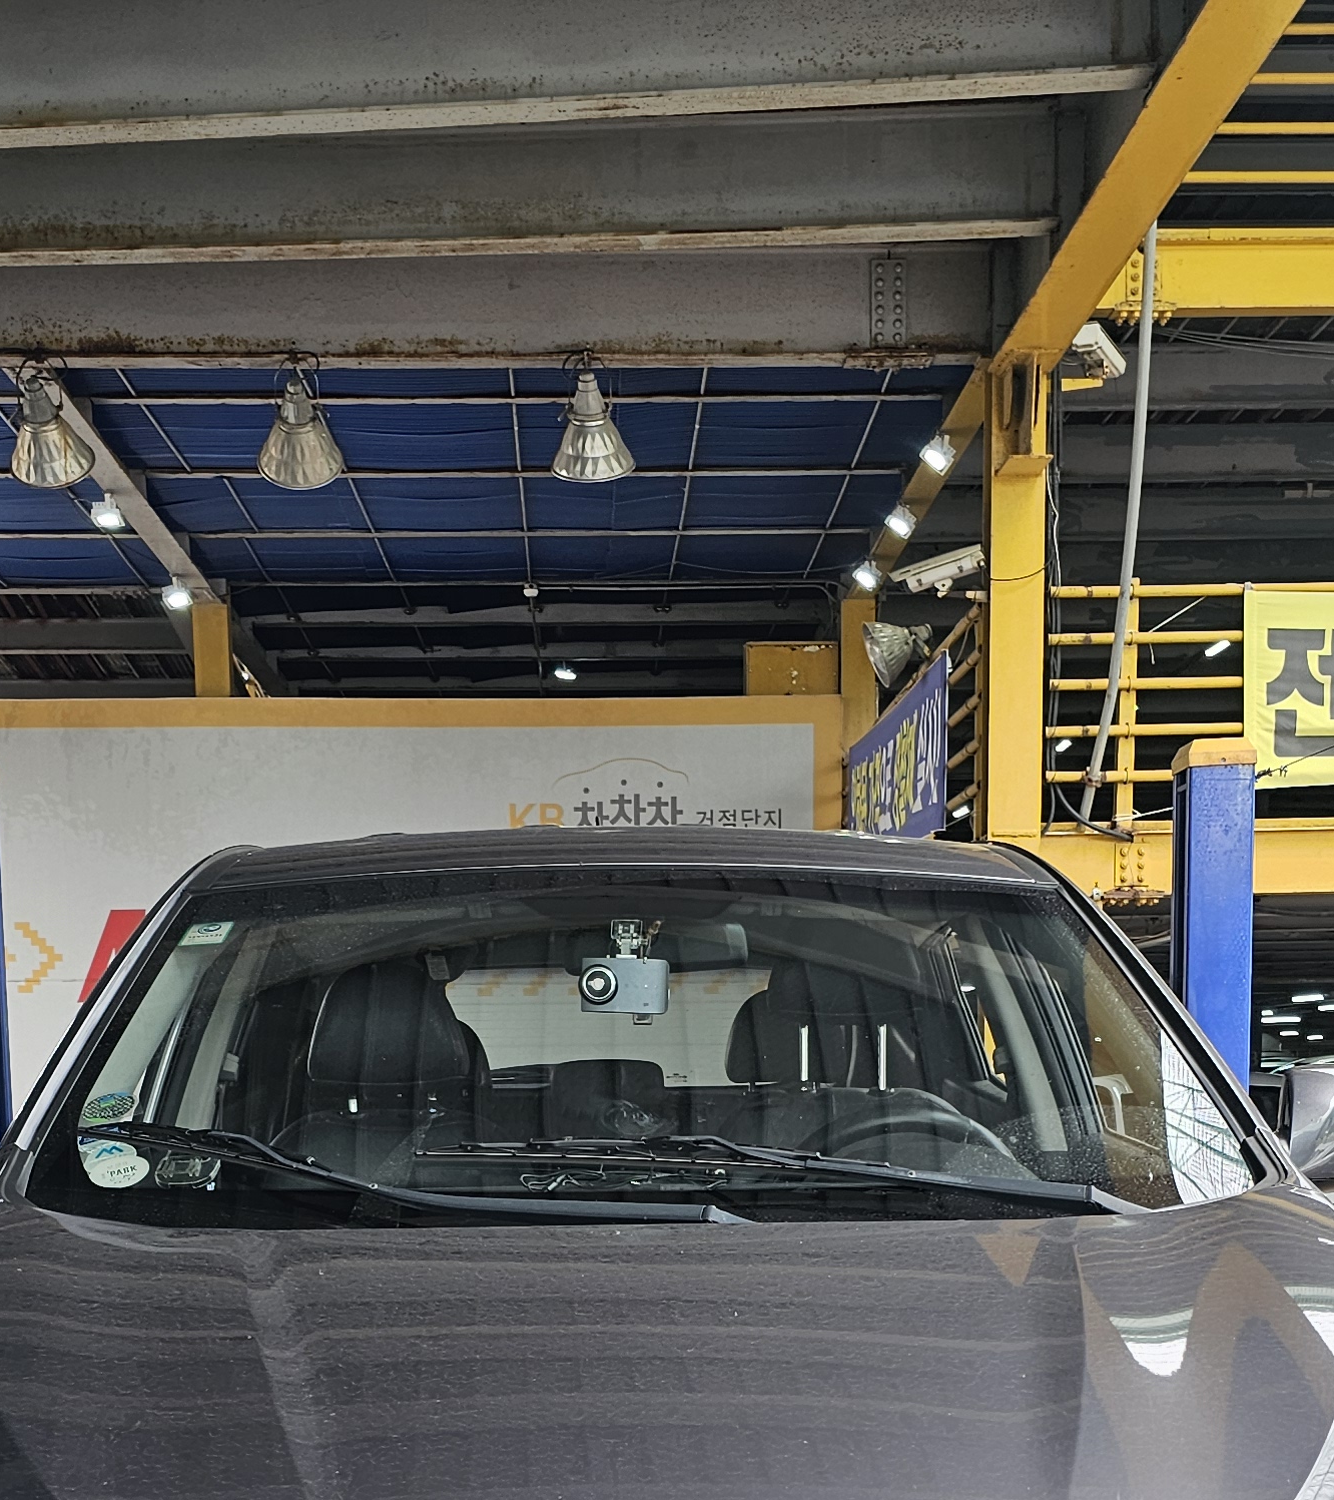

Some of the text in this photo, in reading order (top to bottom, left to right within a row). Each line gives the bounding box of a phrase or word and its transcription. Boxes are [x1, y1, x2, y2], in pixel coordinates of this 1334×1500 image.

[508, 793, 782, 829] KB 차차차 거점단지
